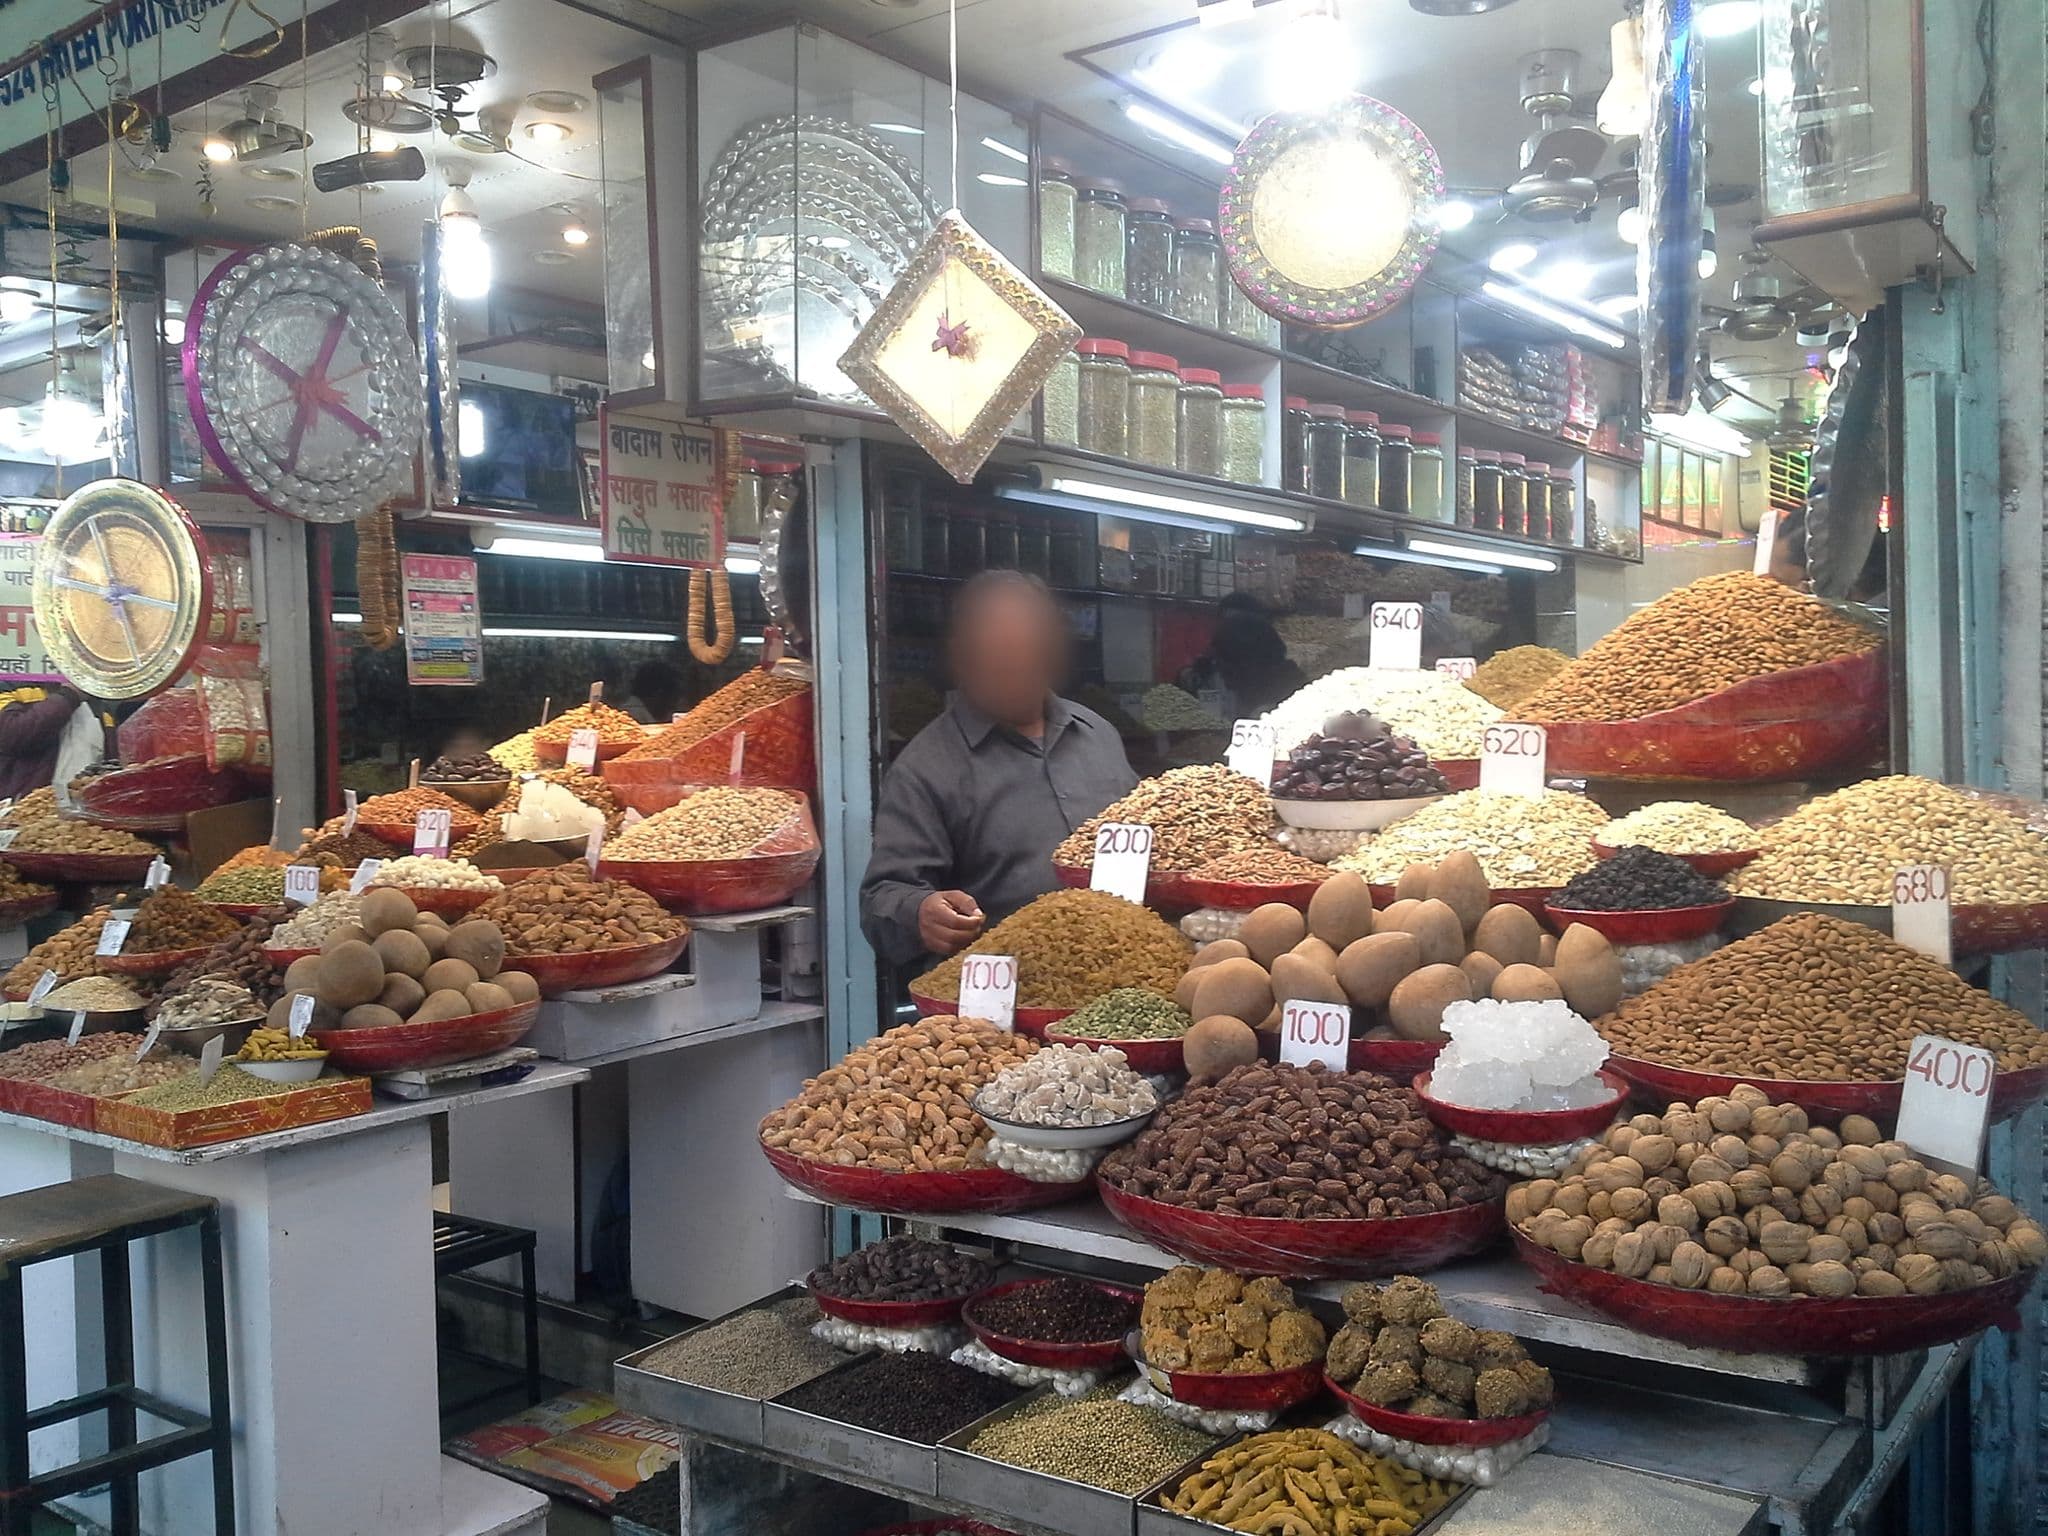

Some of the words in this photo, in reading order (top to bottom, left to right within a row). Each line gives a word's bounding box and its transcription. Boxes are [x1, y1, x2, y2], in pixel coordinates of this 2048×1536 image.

[671, 423, 712, 464] रोगन
[607, 475, 657, 519] साबुत
[617, 514, 652, 555] पिसे
[1373, 606, 1422, 630] 640
[1484, 727, 1541, 756] 620
[1099, 828, 1149, 854] 200
[287, 869, 319, 891] 100
[1894, 867, 1948, 904] 680
[963, 961, 1012, 990] 100
[1287, 1008, 1344, 1046] 100
[1908, 1043, 1992, 1096] 400
